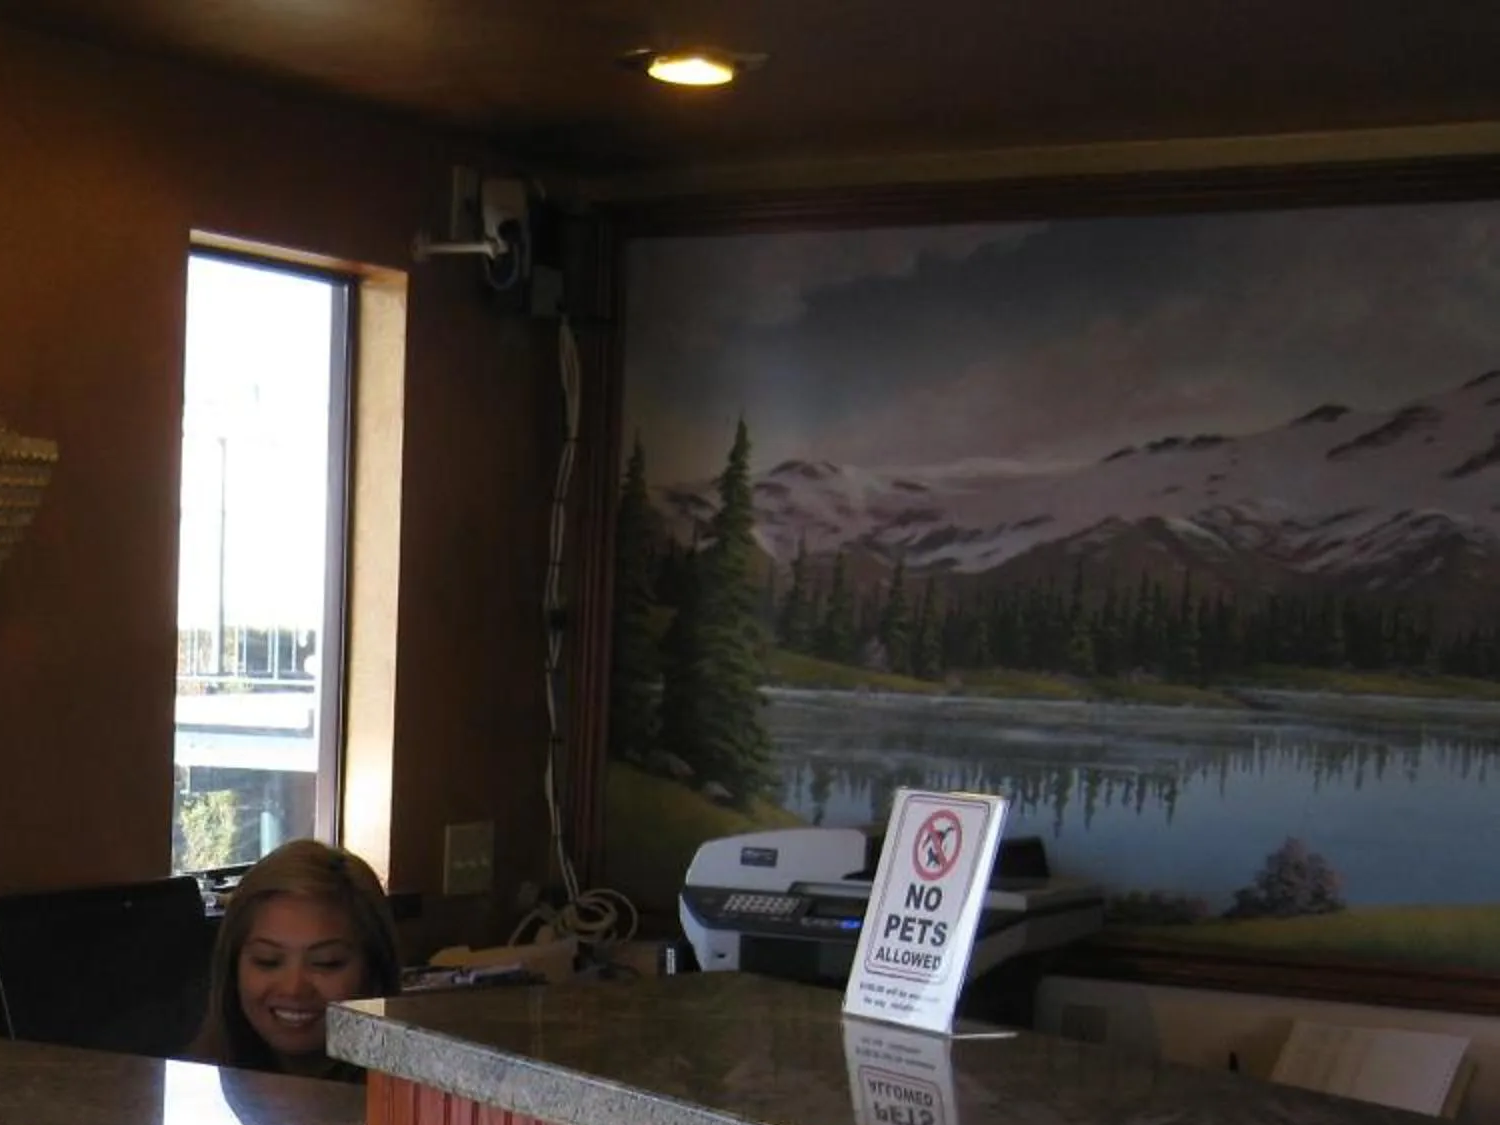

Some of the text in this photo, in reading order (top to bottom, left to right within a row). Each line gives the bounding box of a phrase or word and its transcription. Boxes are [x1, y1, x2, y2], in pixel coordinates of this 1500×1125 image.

[905, 882, 943, 912] NO
[884, 913, 948, 947] PETS
[873, 946, 943, 971] ALLOWED
